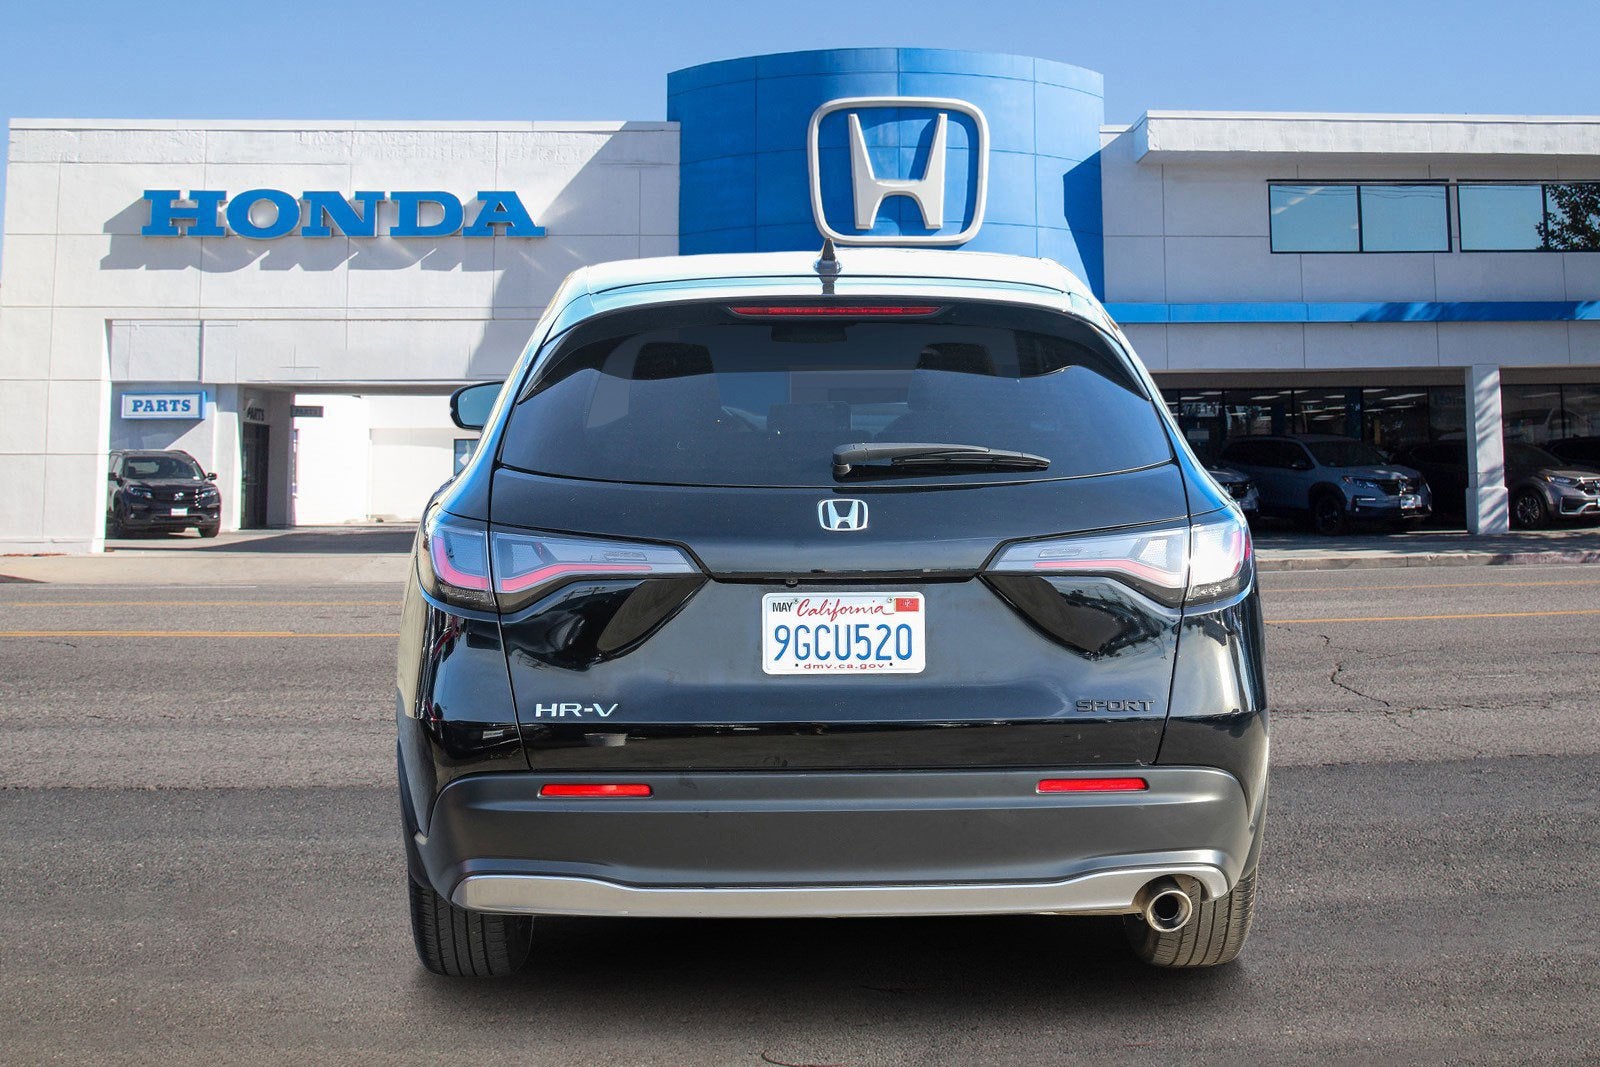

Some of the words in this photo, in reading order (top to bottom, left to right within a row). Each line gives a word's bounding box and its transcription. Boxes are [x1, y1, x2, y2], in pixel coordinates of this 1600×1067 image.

[141, 188, 547, 239] HONDA
[131, 399, 192, 413] PARTS
[772, 602, 793, 613] MAY
[796, 598, 895, 622] California
[773, 623, 913, 661] 9GCU520
[803, 662, 885, 670] dmv.ca.gov
[535, 703, 619, 718] HR-V
[1076, 699, 1155, 713] SPORT
